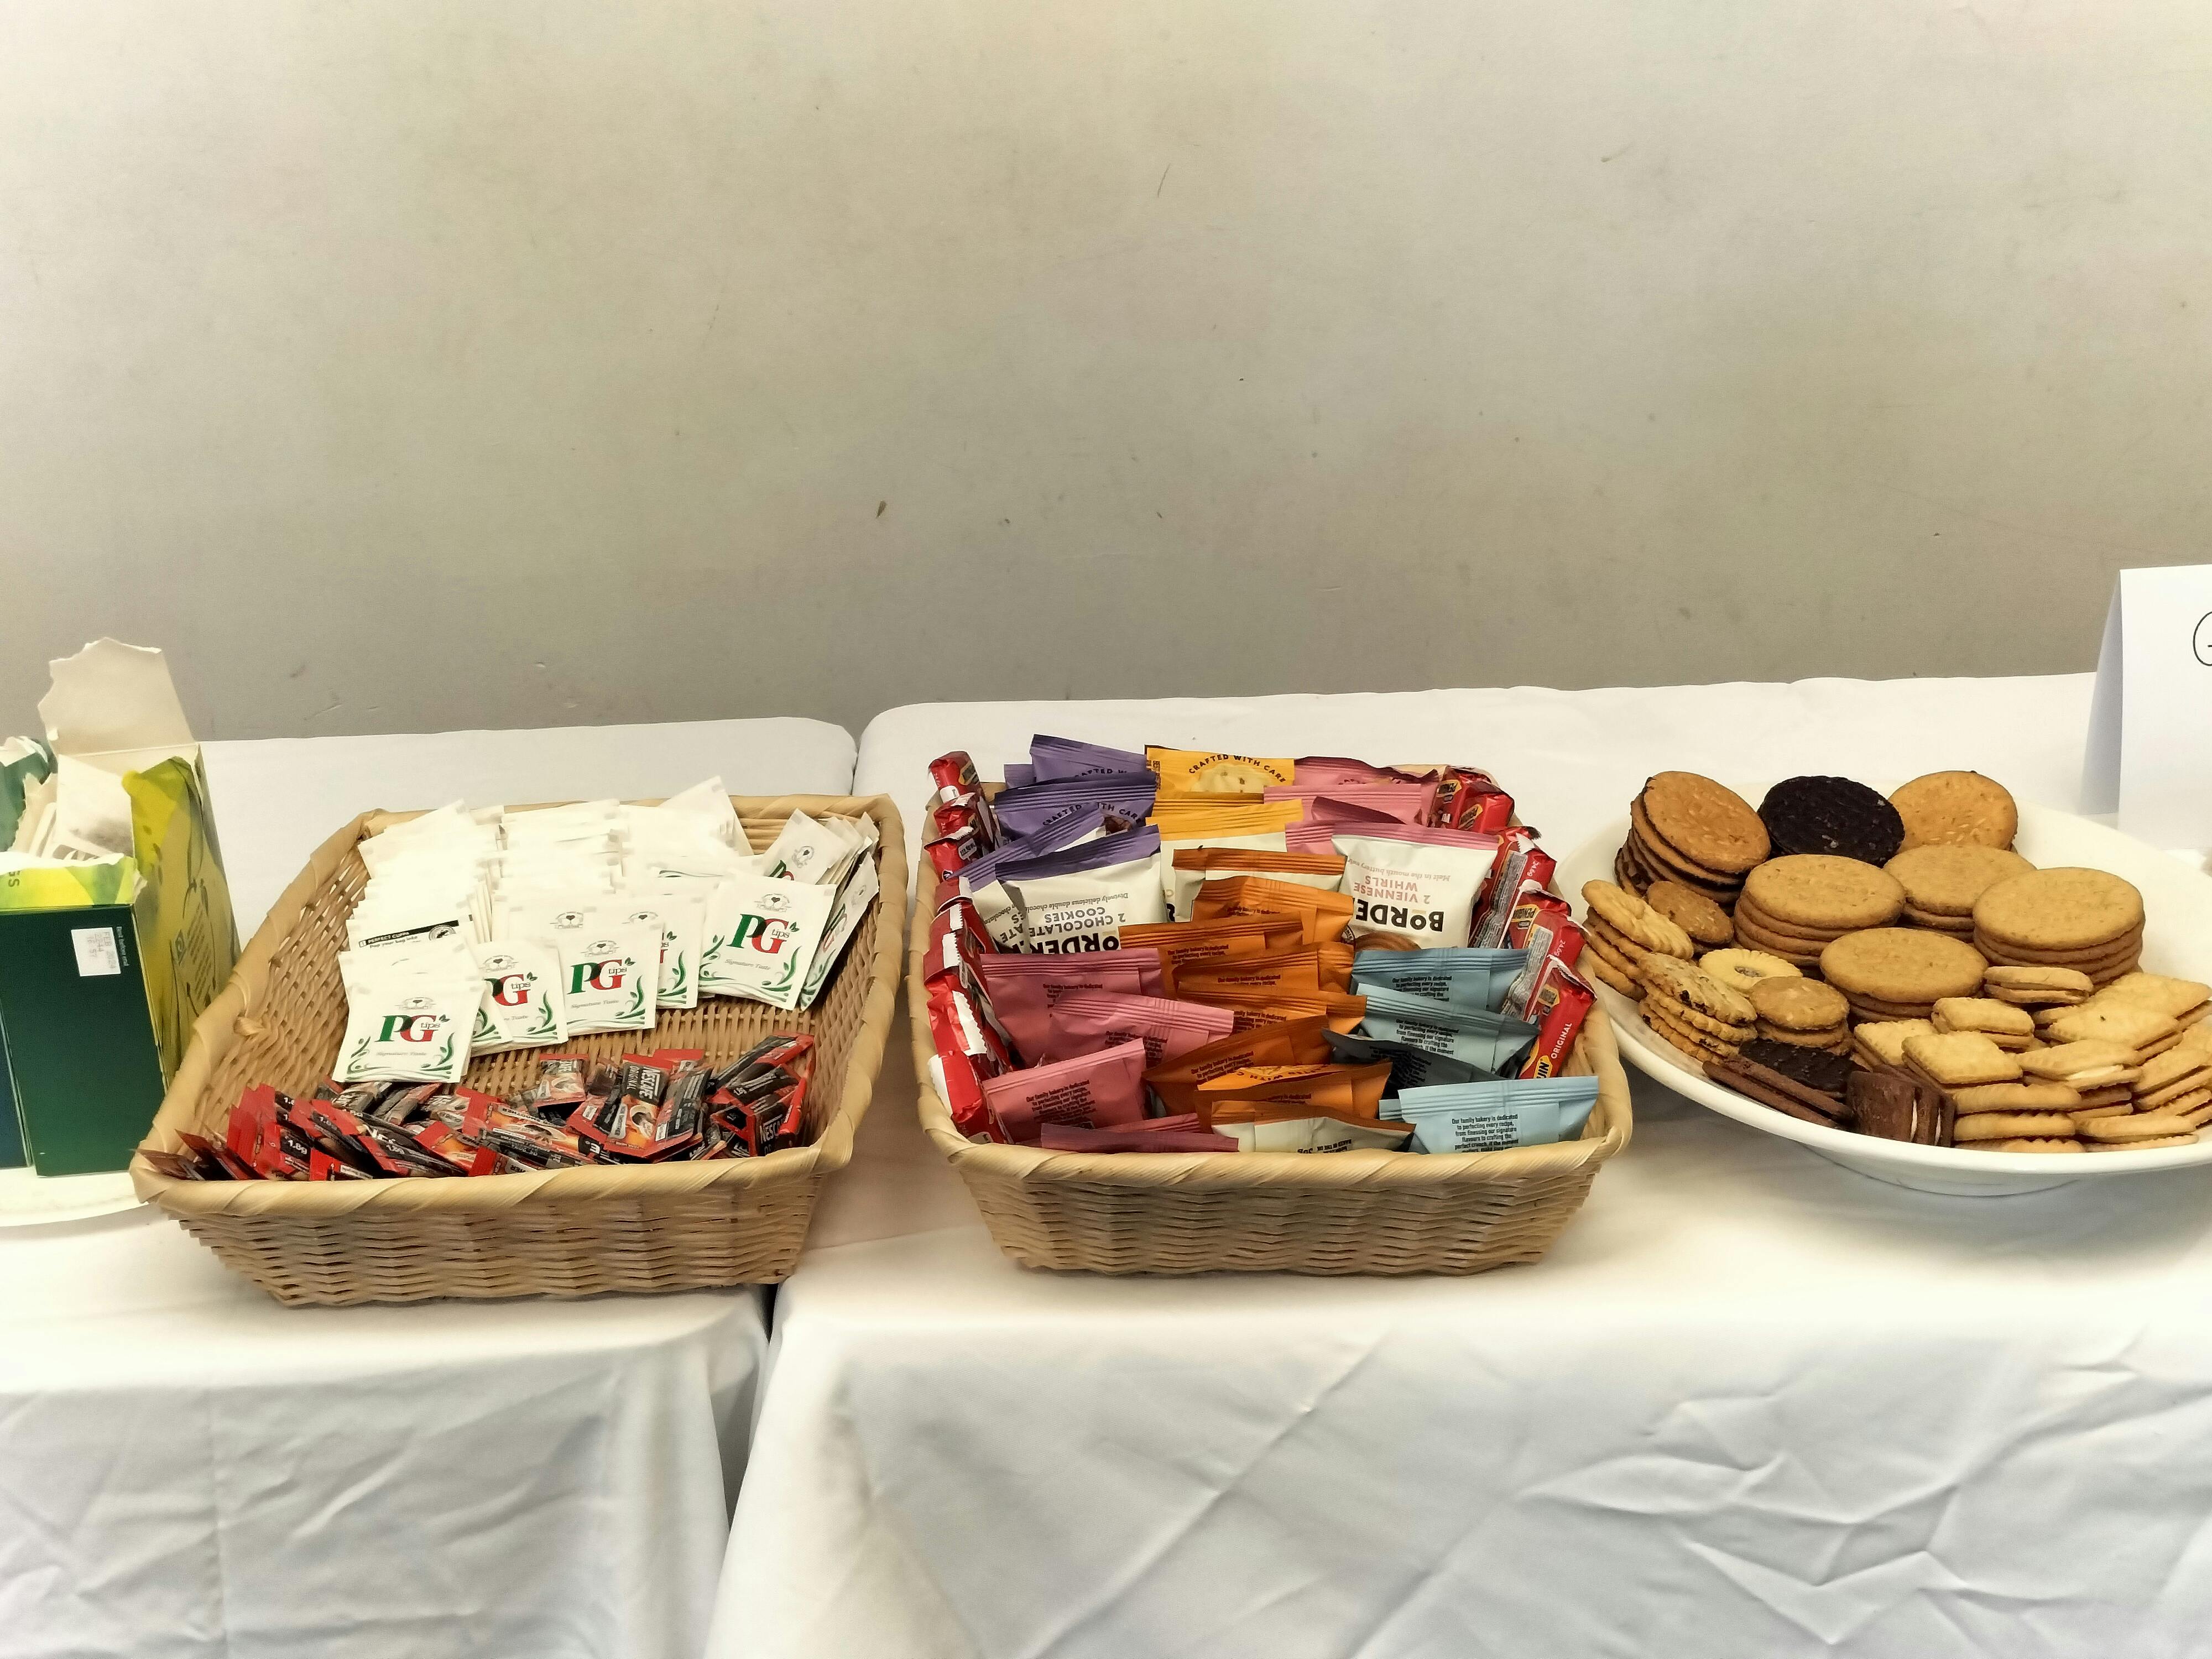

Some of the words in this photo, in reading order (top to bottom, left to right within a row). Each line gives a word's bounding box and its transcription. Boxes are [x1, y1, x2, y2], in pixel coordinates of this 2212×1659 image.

[1074, 768, 1113, 777] AFTED
[1189, 754, 1229, 774] CRAFTED
[1233, 755, 1261, 766] WITH
[1264, 765, 1286, 782] CARE
[1119, 808, 1142, 824] CARE
[1353, 881, 1418, 903] VIENNESE
[1365, 875, 1418, 892] WHIRLS
[1048, 900, 1071, 910] double
[1071, 897, 1100, 907] delicious
[1423, 895, 1431, 904] 2
[1045, 906, 1105, 924] COOKIES
[1118, 913, 1125, 922] 2
[1355, 899, 1444, 932] BORDE
[726, 914, 789, 953] PG
[772, 929, 790, 938] tips
[1029, 915, 1114, 937] CHOCOLATE
[566, 959, 626, 995] PG
[511, 982, 531, 990] tips
[374, 1015, 437, 1042] PG
[1551, 1022, 1573, 1059] ORIGINAL
[627, 1066, 640, 1090] ORIGINAL
[288, 1140, 307, 1155] 1.8g
